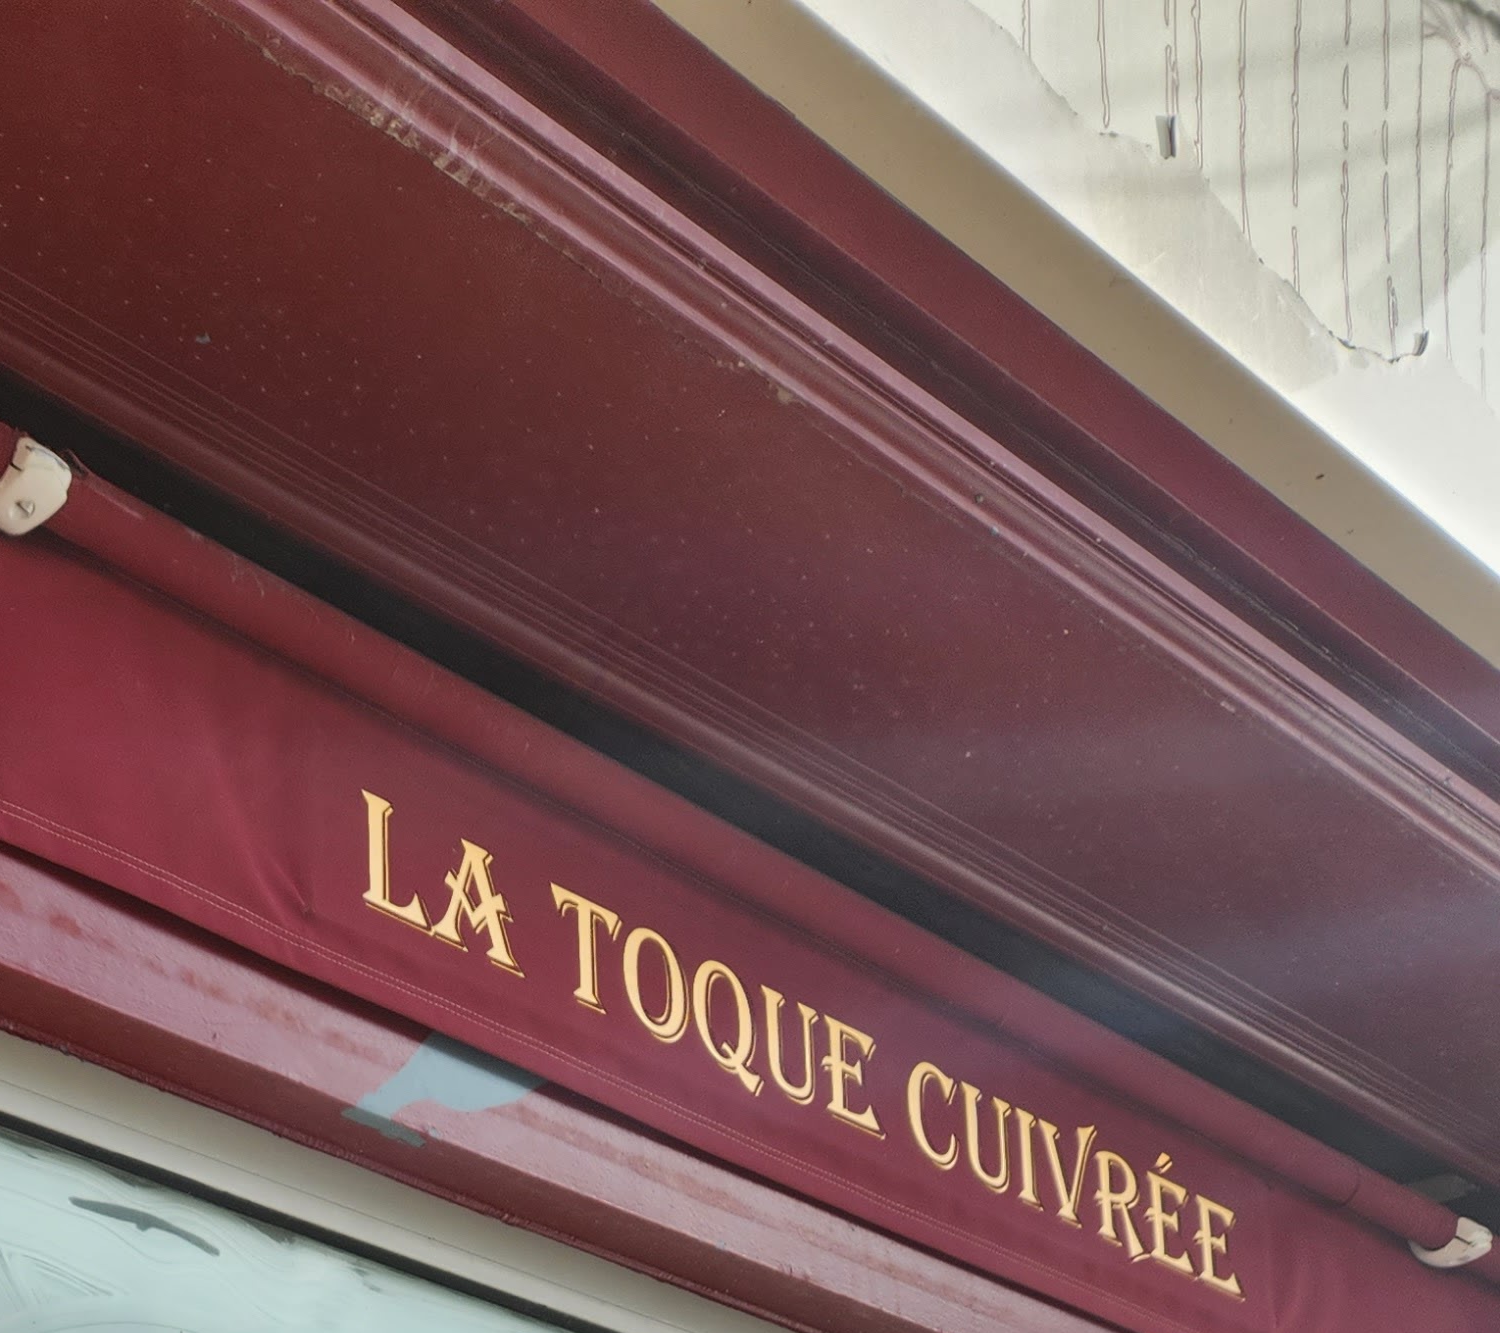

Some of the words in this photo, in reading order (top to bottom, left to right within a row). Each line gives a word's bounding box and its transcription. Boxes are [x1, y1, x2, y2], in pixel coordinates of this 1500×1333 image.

[361, 789, 525, 977] LA
[550, 883, 886, 1138] TOQUE
[907, 1061, 1245, 1300] CUIVRÉE
